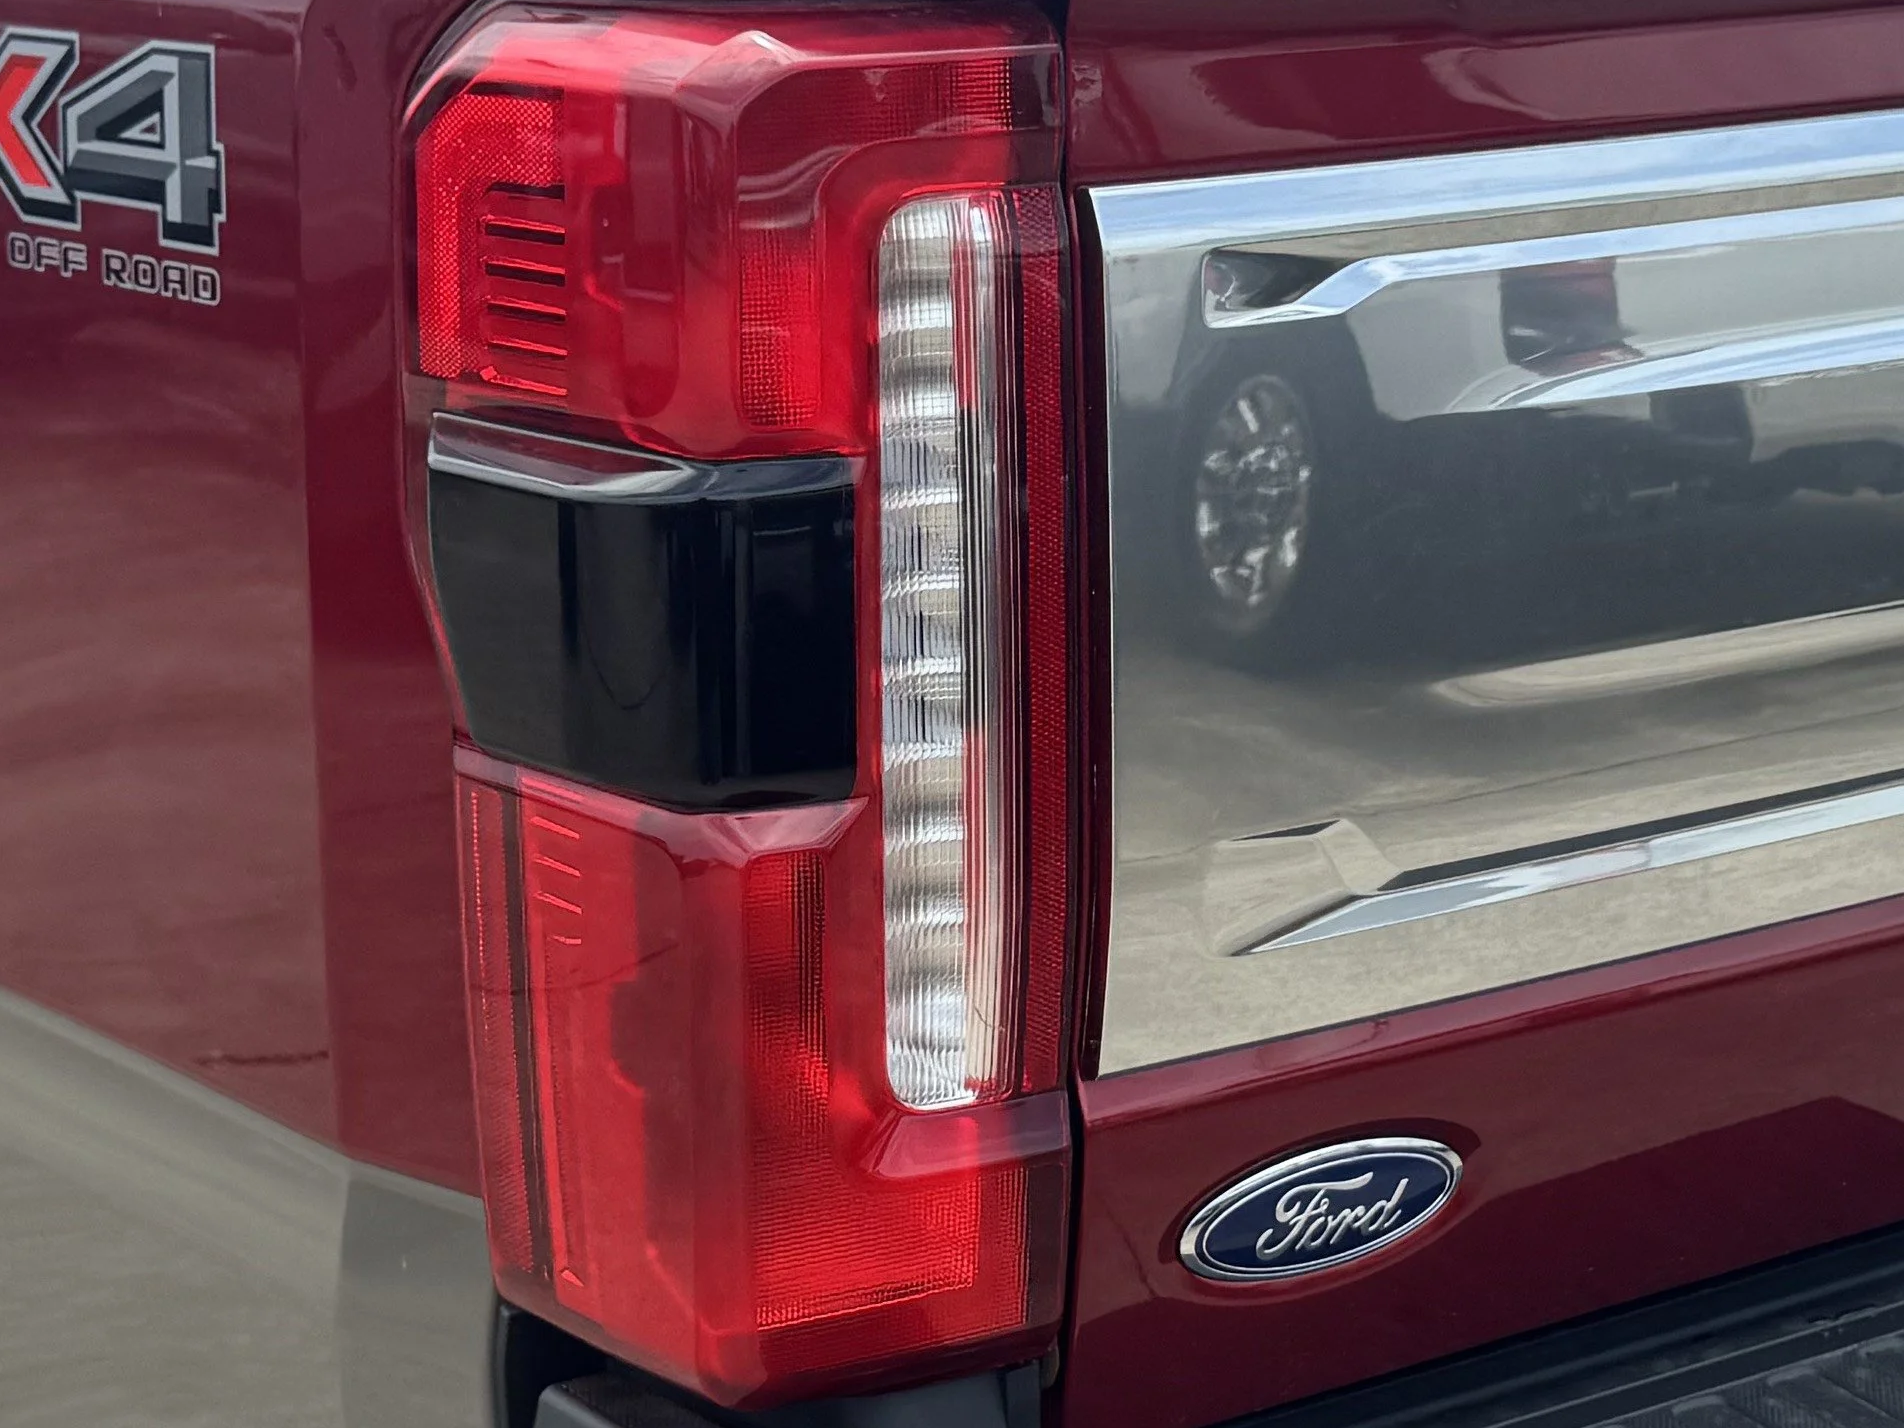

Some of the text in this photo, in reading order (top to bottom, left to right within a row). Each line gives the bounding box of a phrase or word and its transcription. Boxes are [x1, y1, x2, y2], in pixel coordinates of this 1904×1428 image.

[6, 231, 222, 306] OFF ROAD
[1255, 1171, 1410, 1261] Ford
